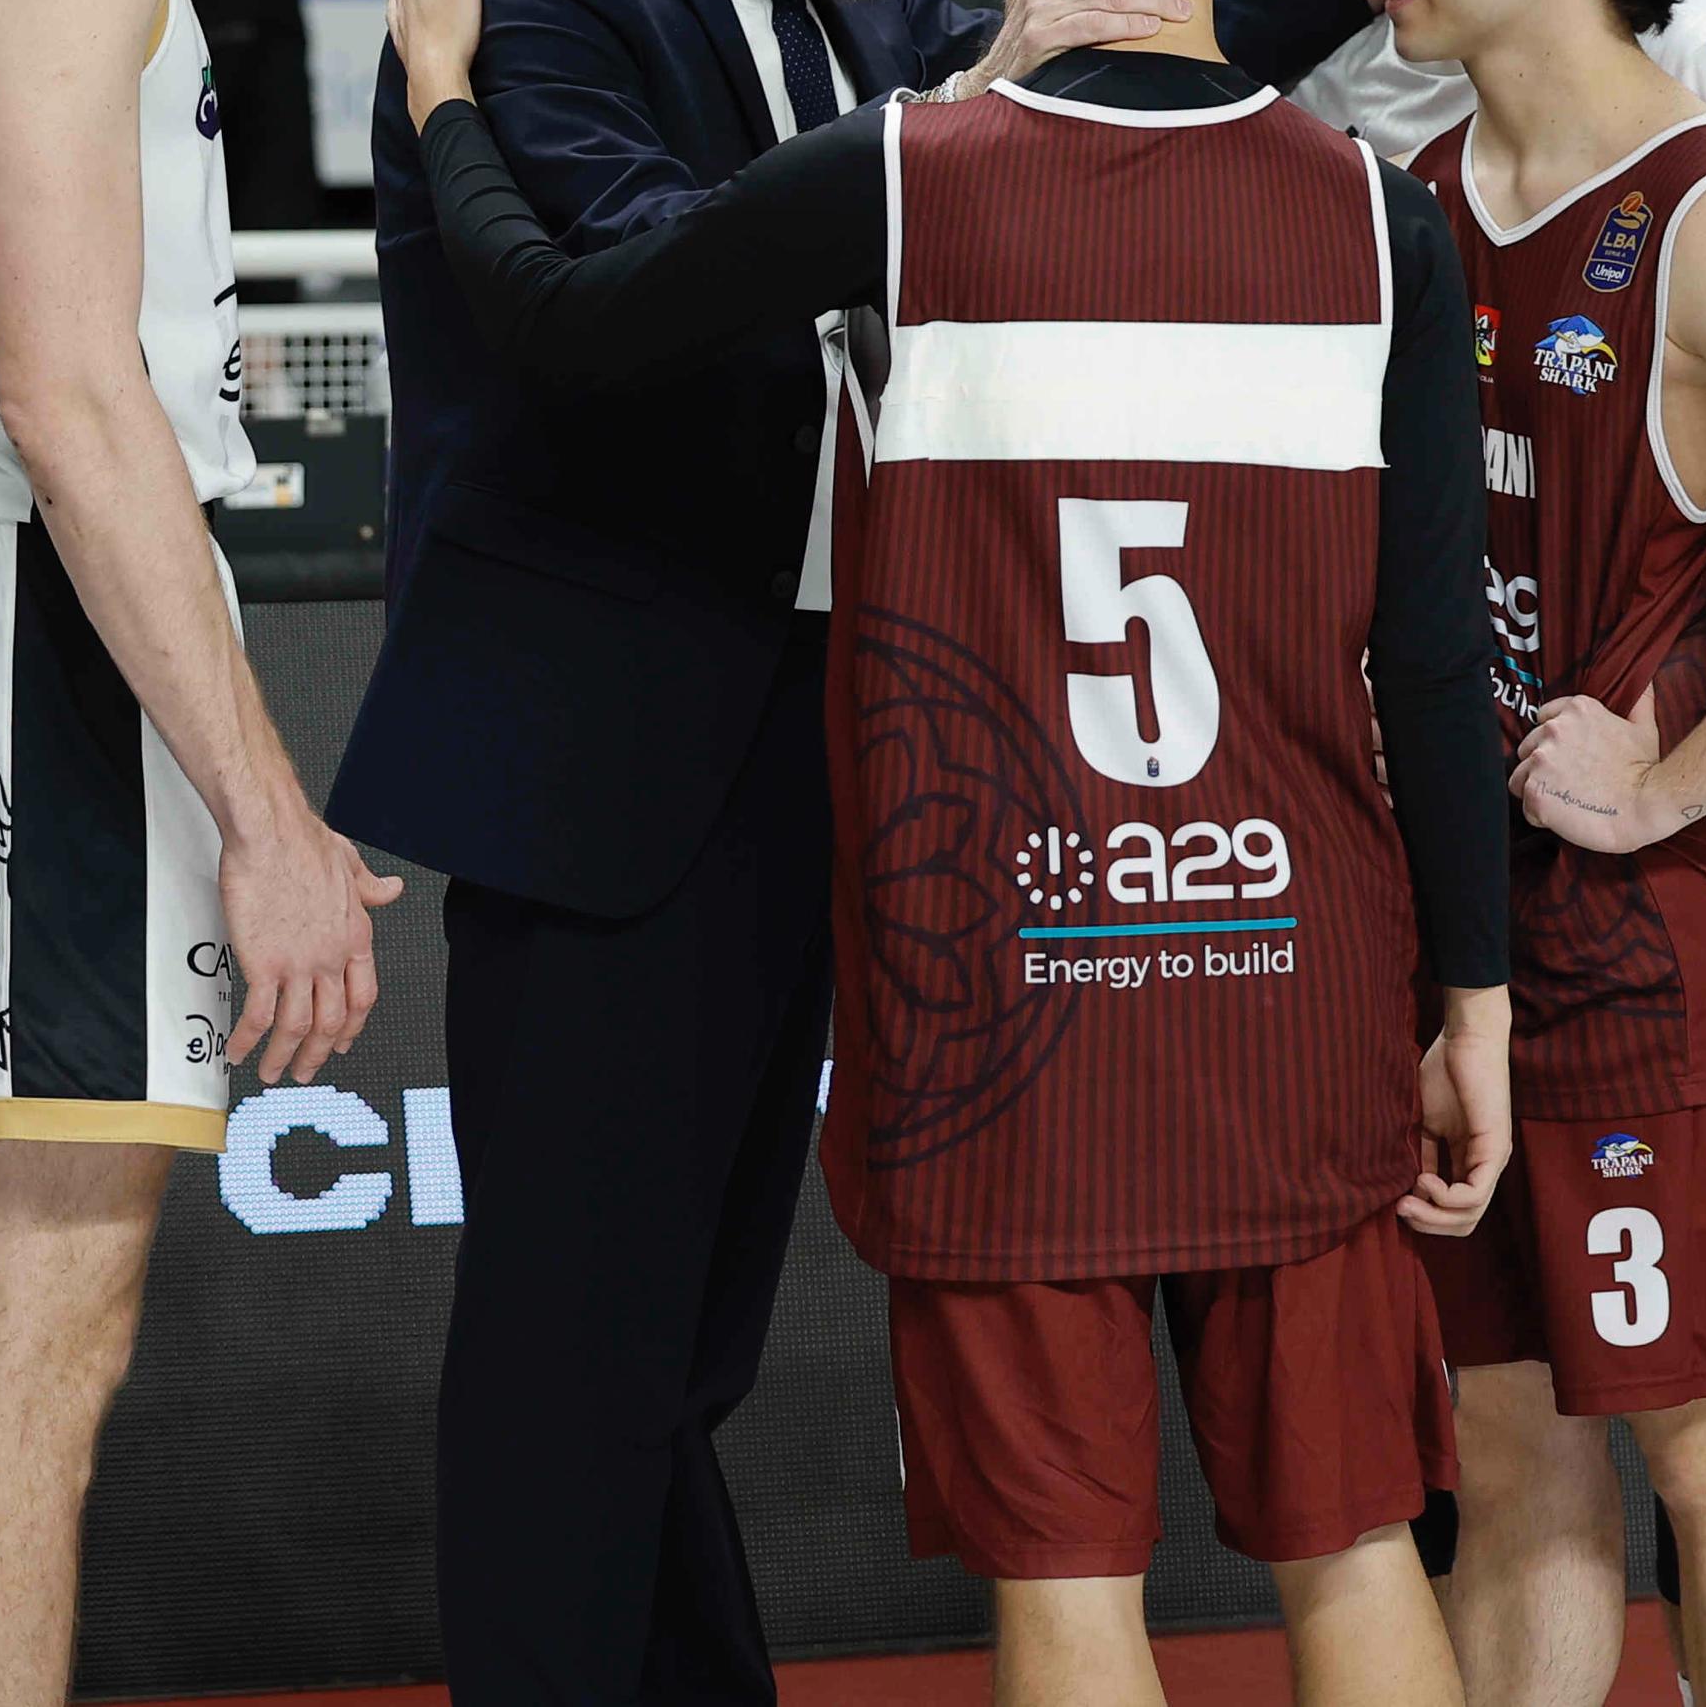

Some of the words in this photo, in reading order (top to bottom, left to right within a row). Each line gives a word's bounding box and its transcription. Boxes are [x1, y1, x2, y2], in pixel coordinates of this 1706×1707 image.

[1602, 230, 1637, 252] LBA
[1594, 263, 1627, 282] Unipol
[1532, 347, 1616, 382] TRAPANI
[1538, 366, 1599, 394] SHARK
[1480, 424, 1536, 499] ANI
[1056, 496, 1221, 788] 5
[1105, 817, 1292, 904] a29
[186, 941, 233, 982] CA
[1023, 952, 1152, 990] Energy
[1157, 949, 1195, 979] to
[1203, 941, 1295, 977] build
[1591, 1153, 1654, 1171] TRAPANI
[1602, 1165, 1644, 1179] SHARK
[1586, 1206, 1671, 1347] 3
